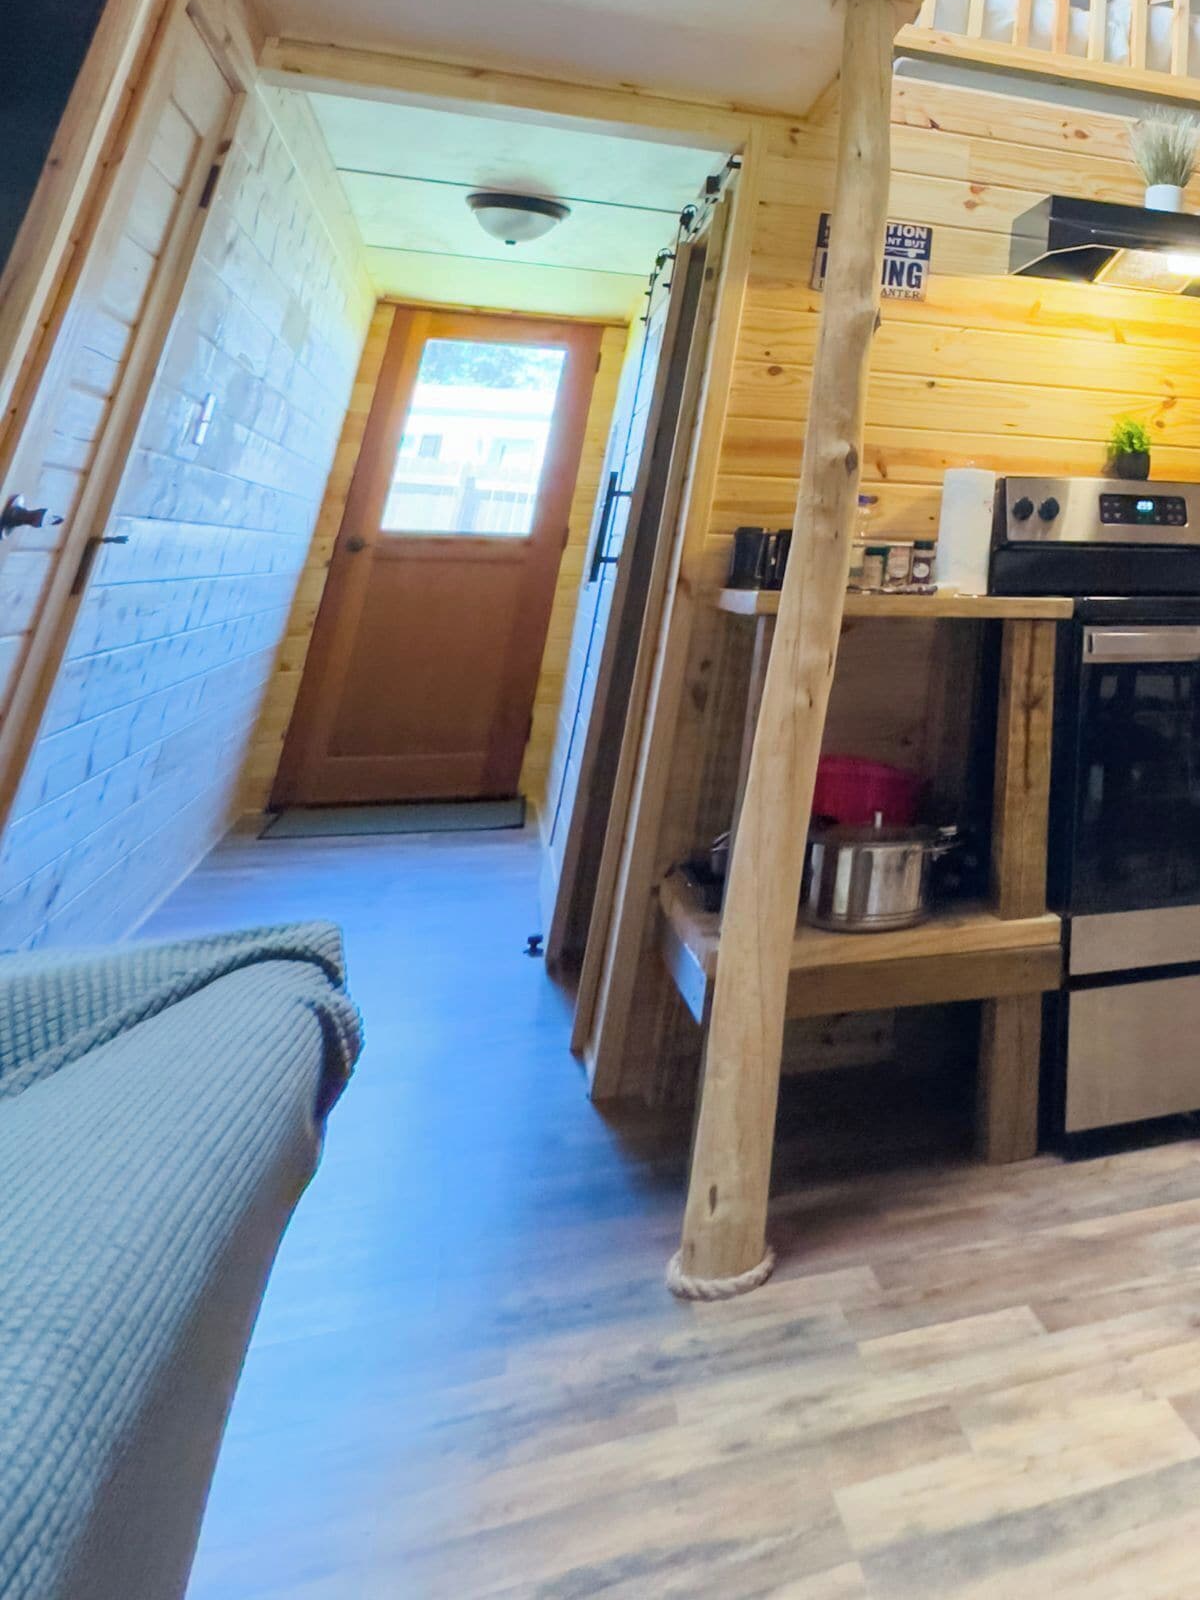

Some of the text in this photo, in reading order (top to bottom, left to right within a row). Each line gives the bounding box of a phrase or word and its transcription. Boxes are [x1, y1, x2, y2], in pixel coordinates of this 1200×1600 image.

[887, 223, 928, 239] TION
[881, 258, 923, 289] ING
[880, 287, 921, 300] ANTER
